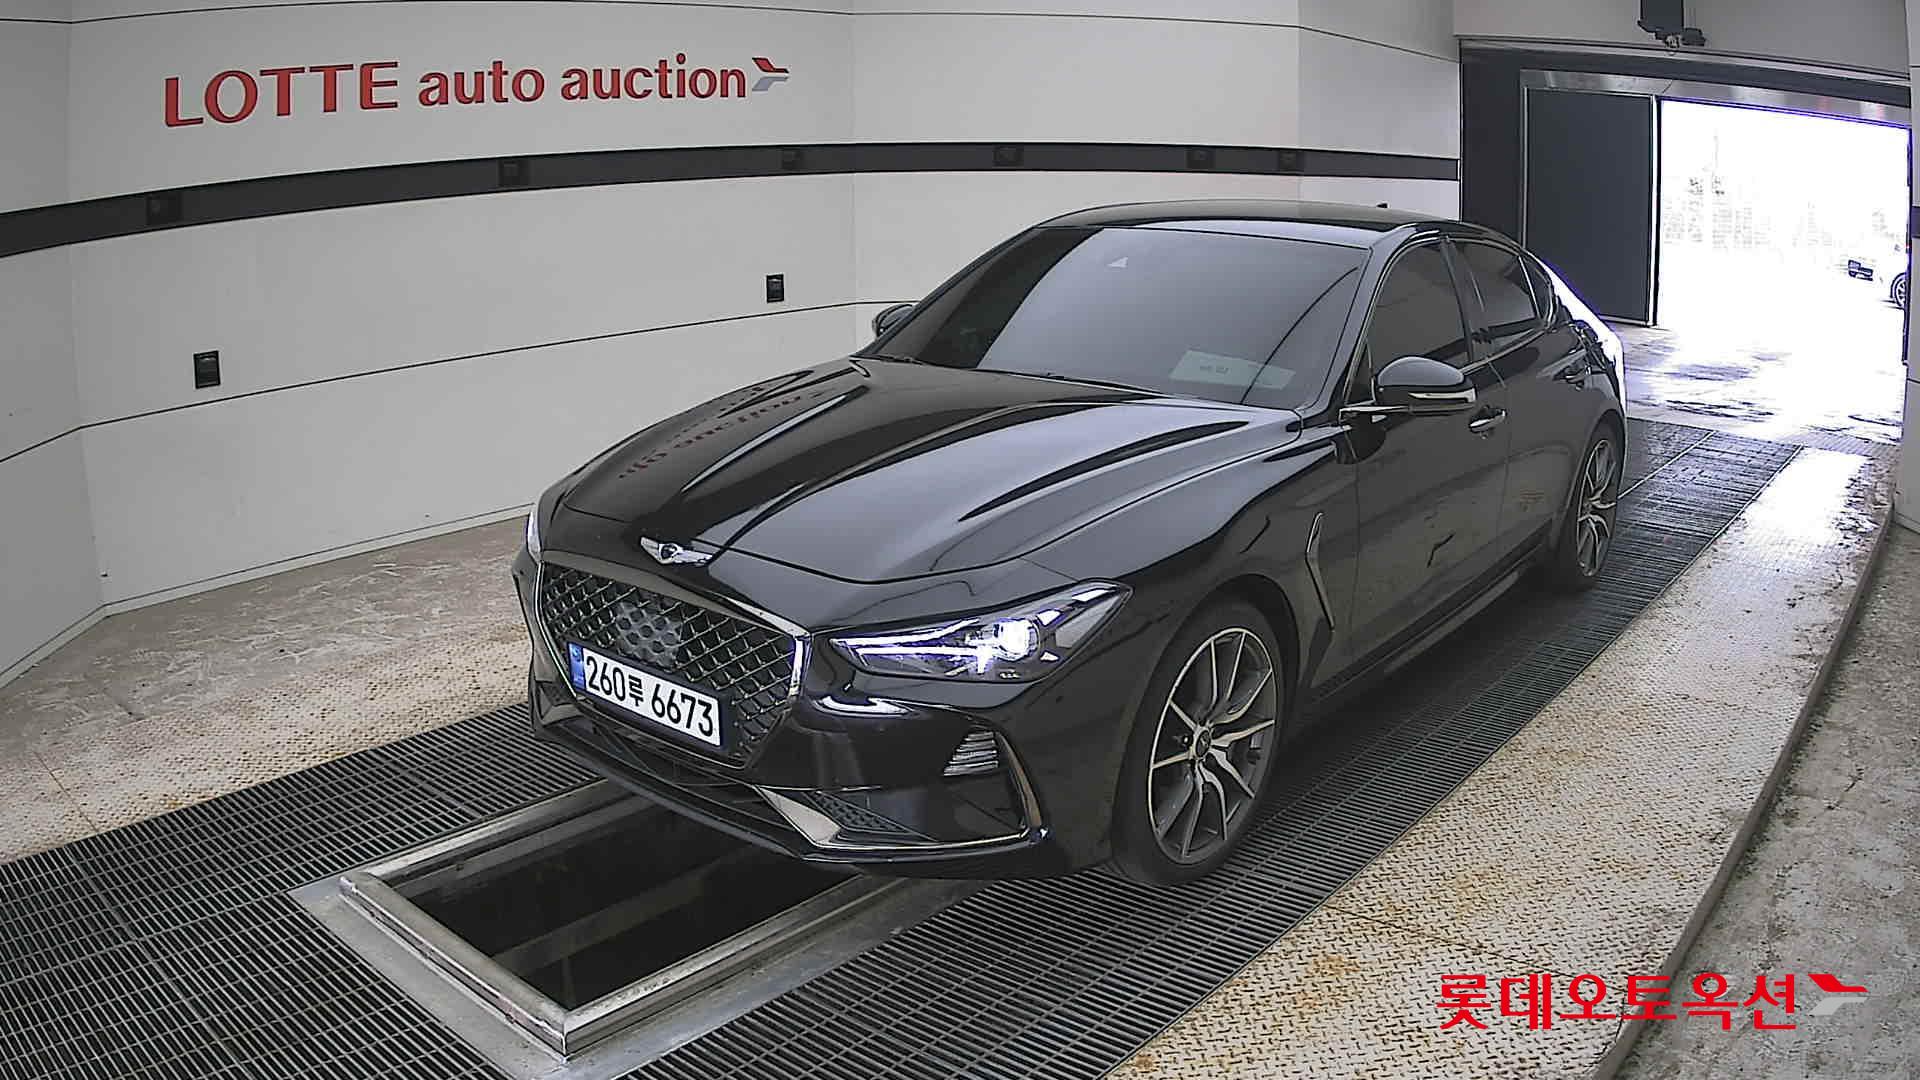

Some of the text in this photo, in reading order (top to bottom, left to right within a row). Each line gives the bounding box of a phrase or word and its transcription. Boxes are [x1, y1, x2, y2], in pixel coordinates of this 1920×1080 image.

[164, 53, 747, 127] LOTTE auto auction
[586, 655, 714, 738] 260루 6673
